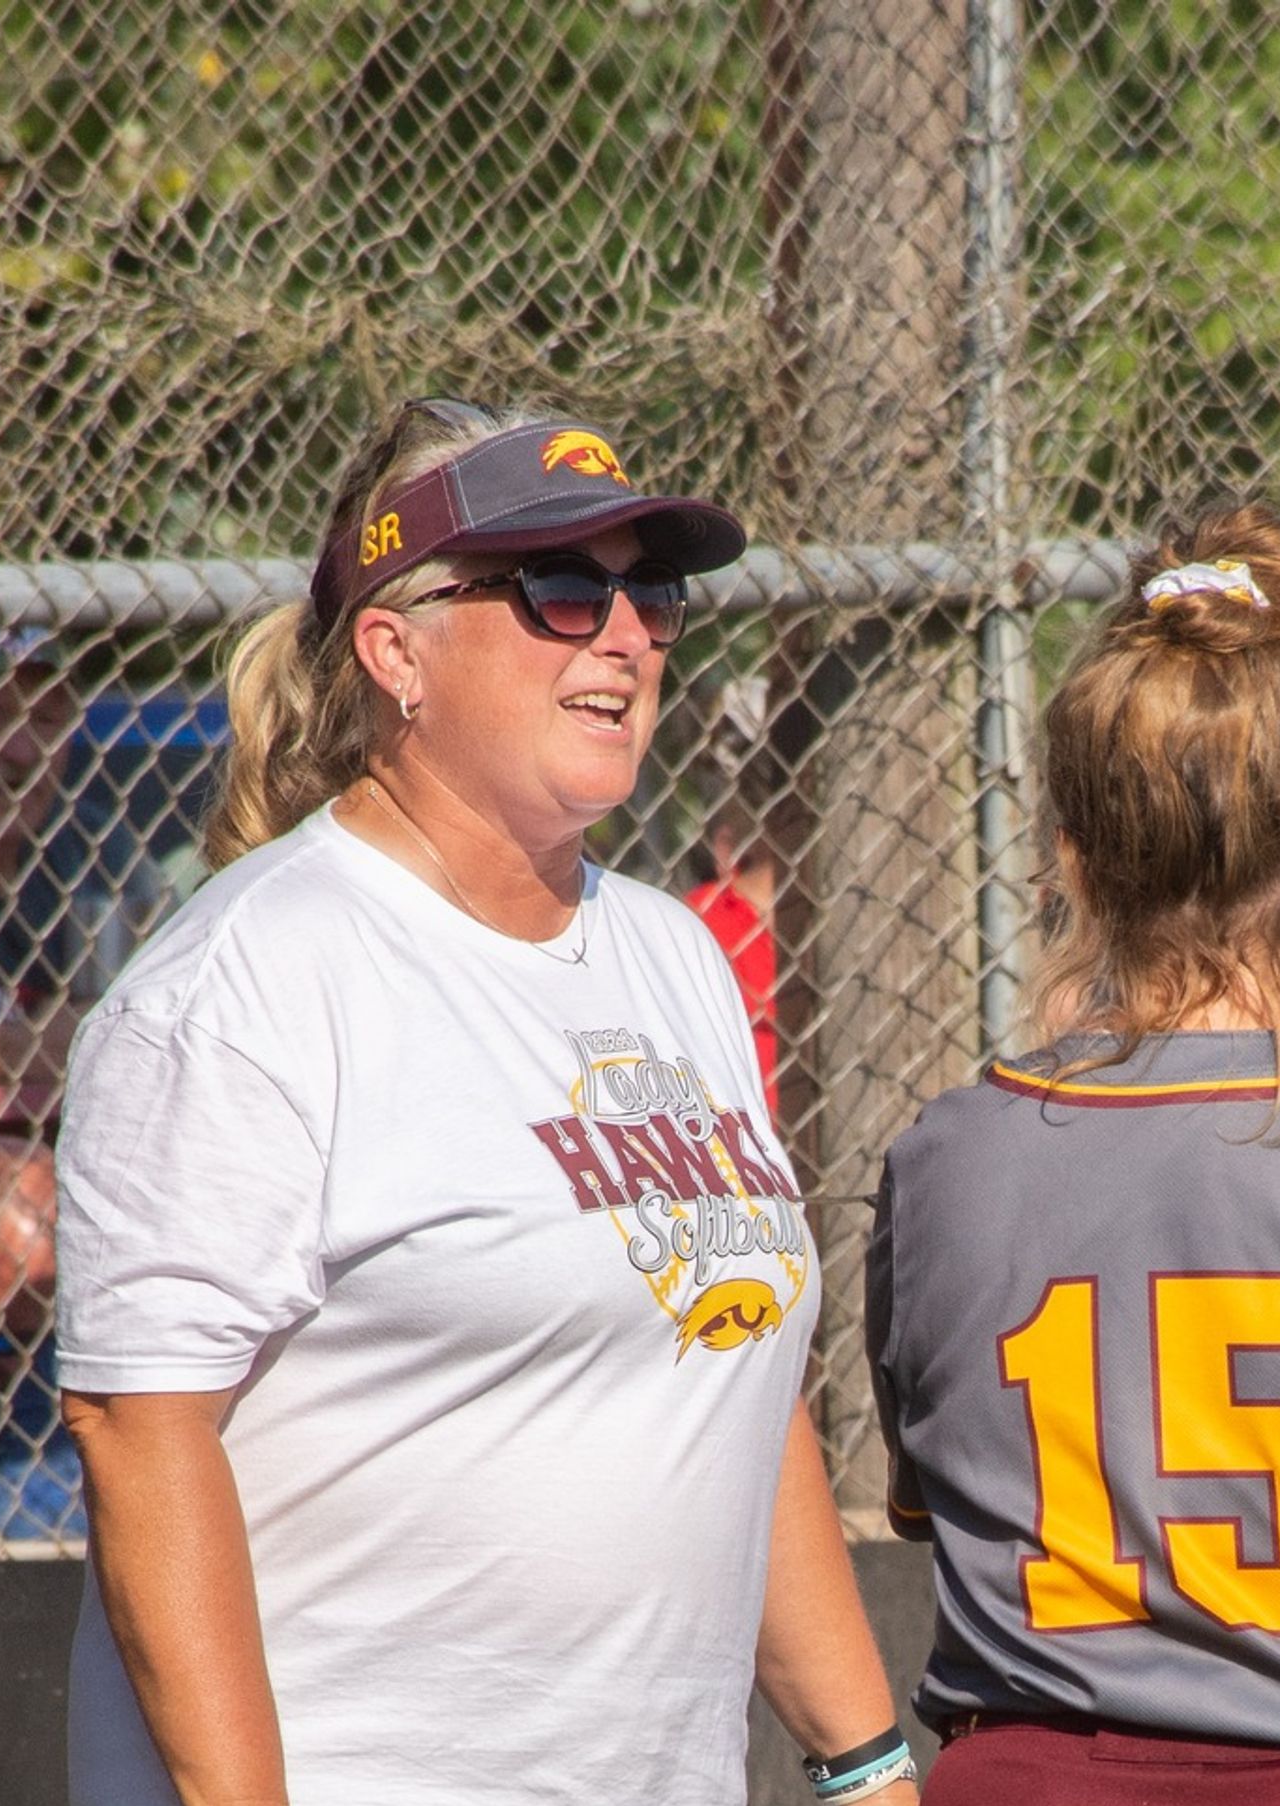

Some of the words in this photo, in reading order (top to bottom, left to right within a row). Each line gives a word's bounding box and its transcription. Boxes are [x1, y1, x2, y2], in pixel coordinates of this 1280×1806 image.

[359, 511, 404, 567] SR
[565, 1028, 720, 1142] Lady
[627, 1188, 806, 1287] Softball
